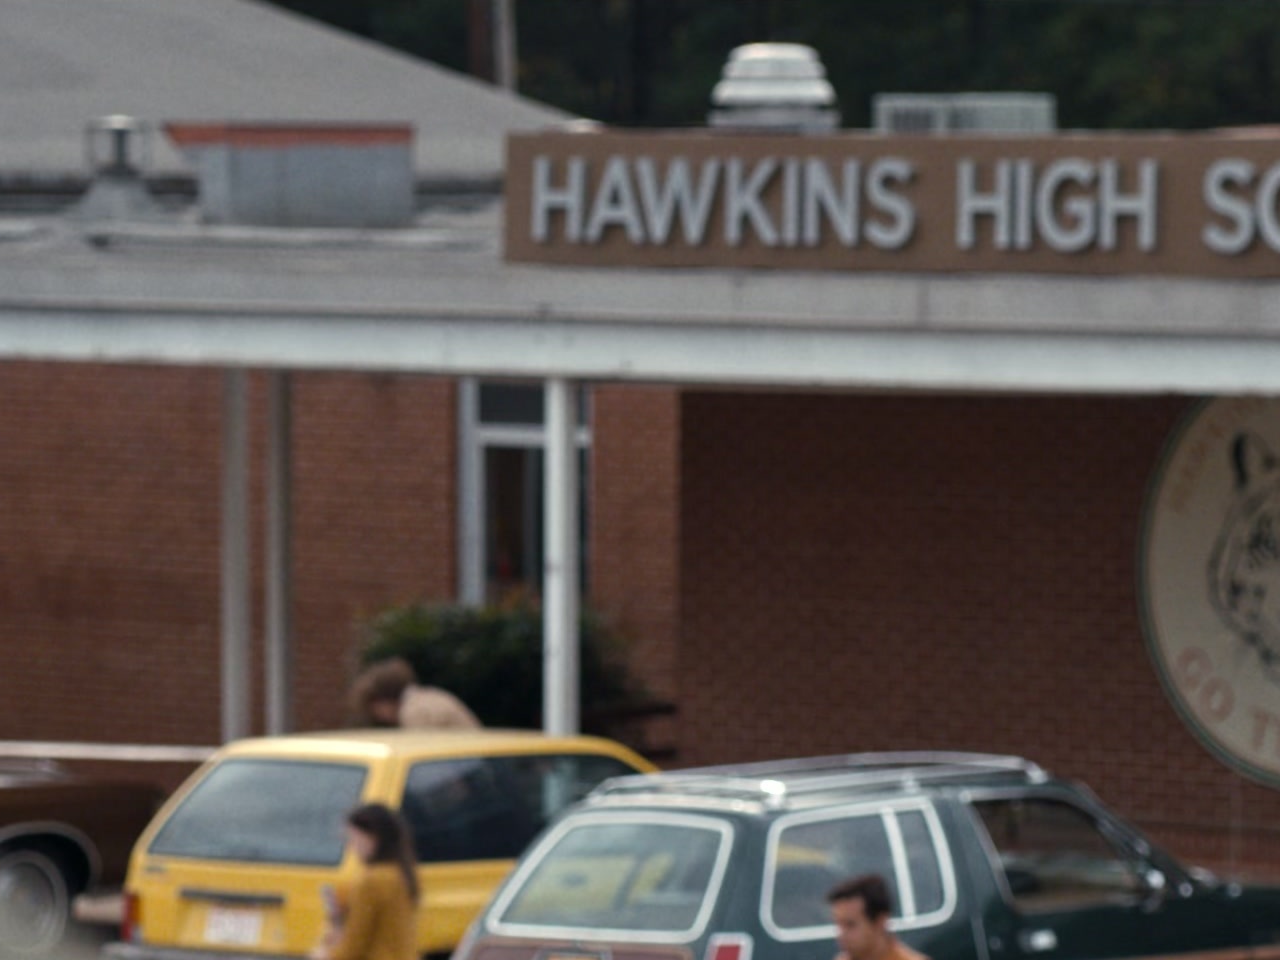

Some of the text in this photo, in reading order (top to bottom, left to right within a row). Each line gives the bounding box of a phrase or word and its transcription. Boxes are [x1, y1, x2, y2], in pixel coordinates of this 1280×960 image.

[531, 155, 917, 250] HAWKINS
[955, 156, 1158, 252] HIGH
[1175, 646, 1236, 723] GO
